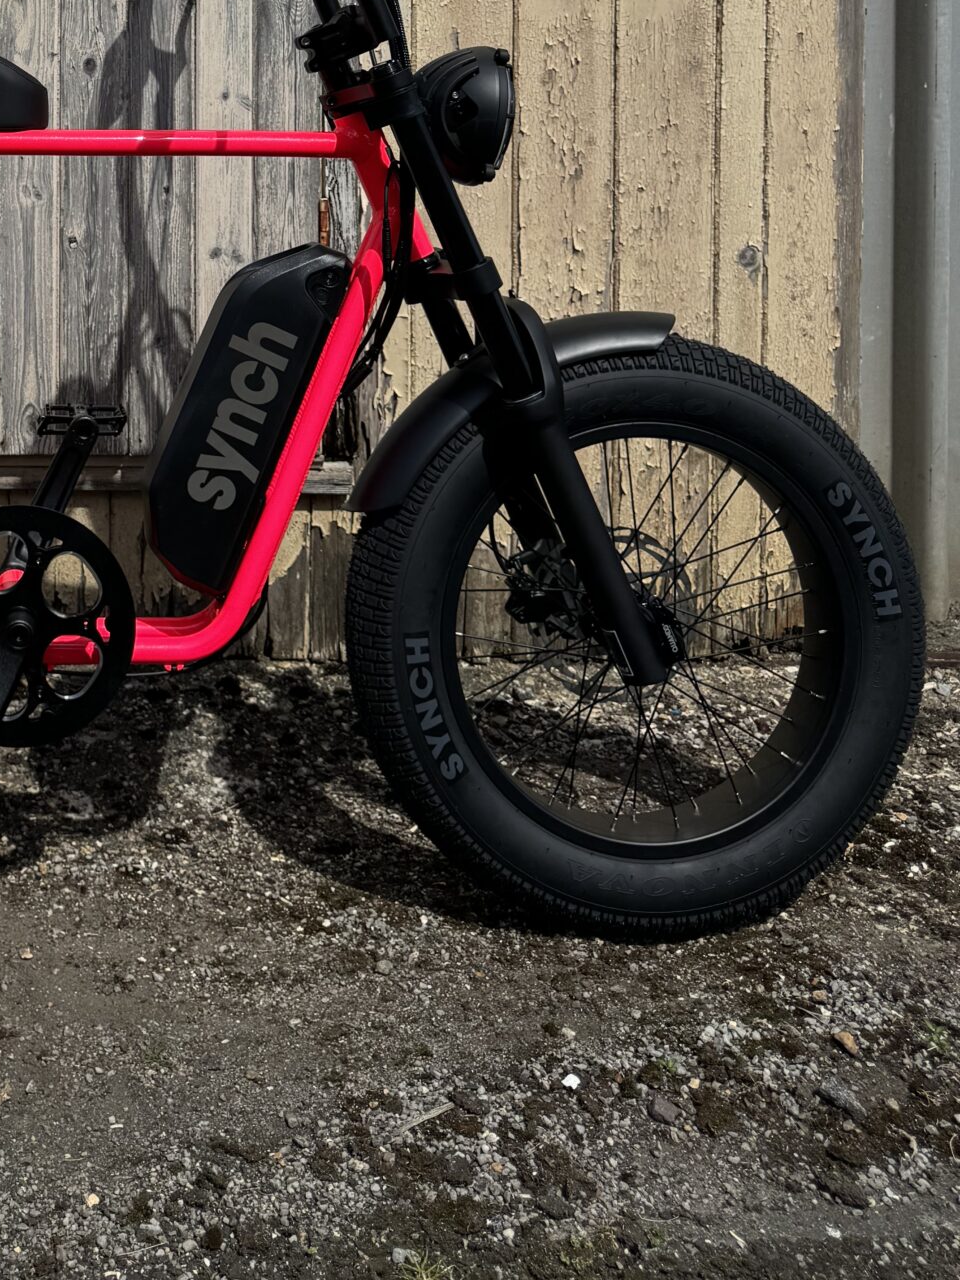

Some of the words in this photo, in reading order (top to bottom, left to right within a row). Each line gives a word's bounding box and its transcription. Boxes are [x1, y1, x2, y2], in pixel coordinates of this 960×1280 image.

[187, 321, 299, 511] synch
[827, 480, 902, 618] SYNCH
[404, 637, 464, 781] SYNCH
